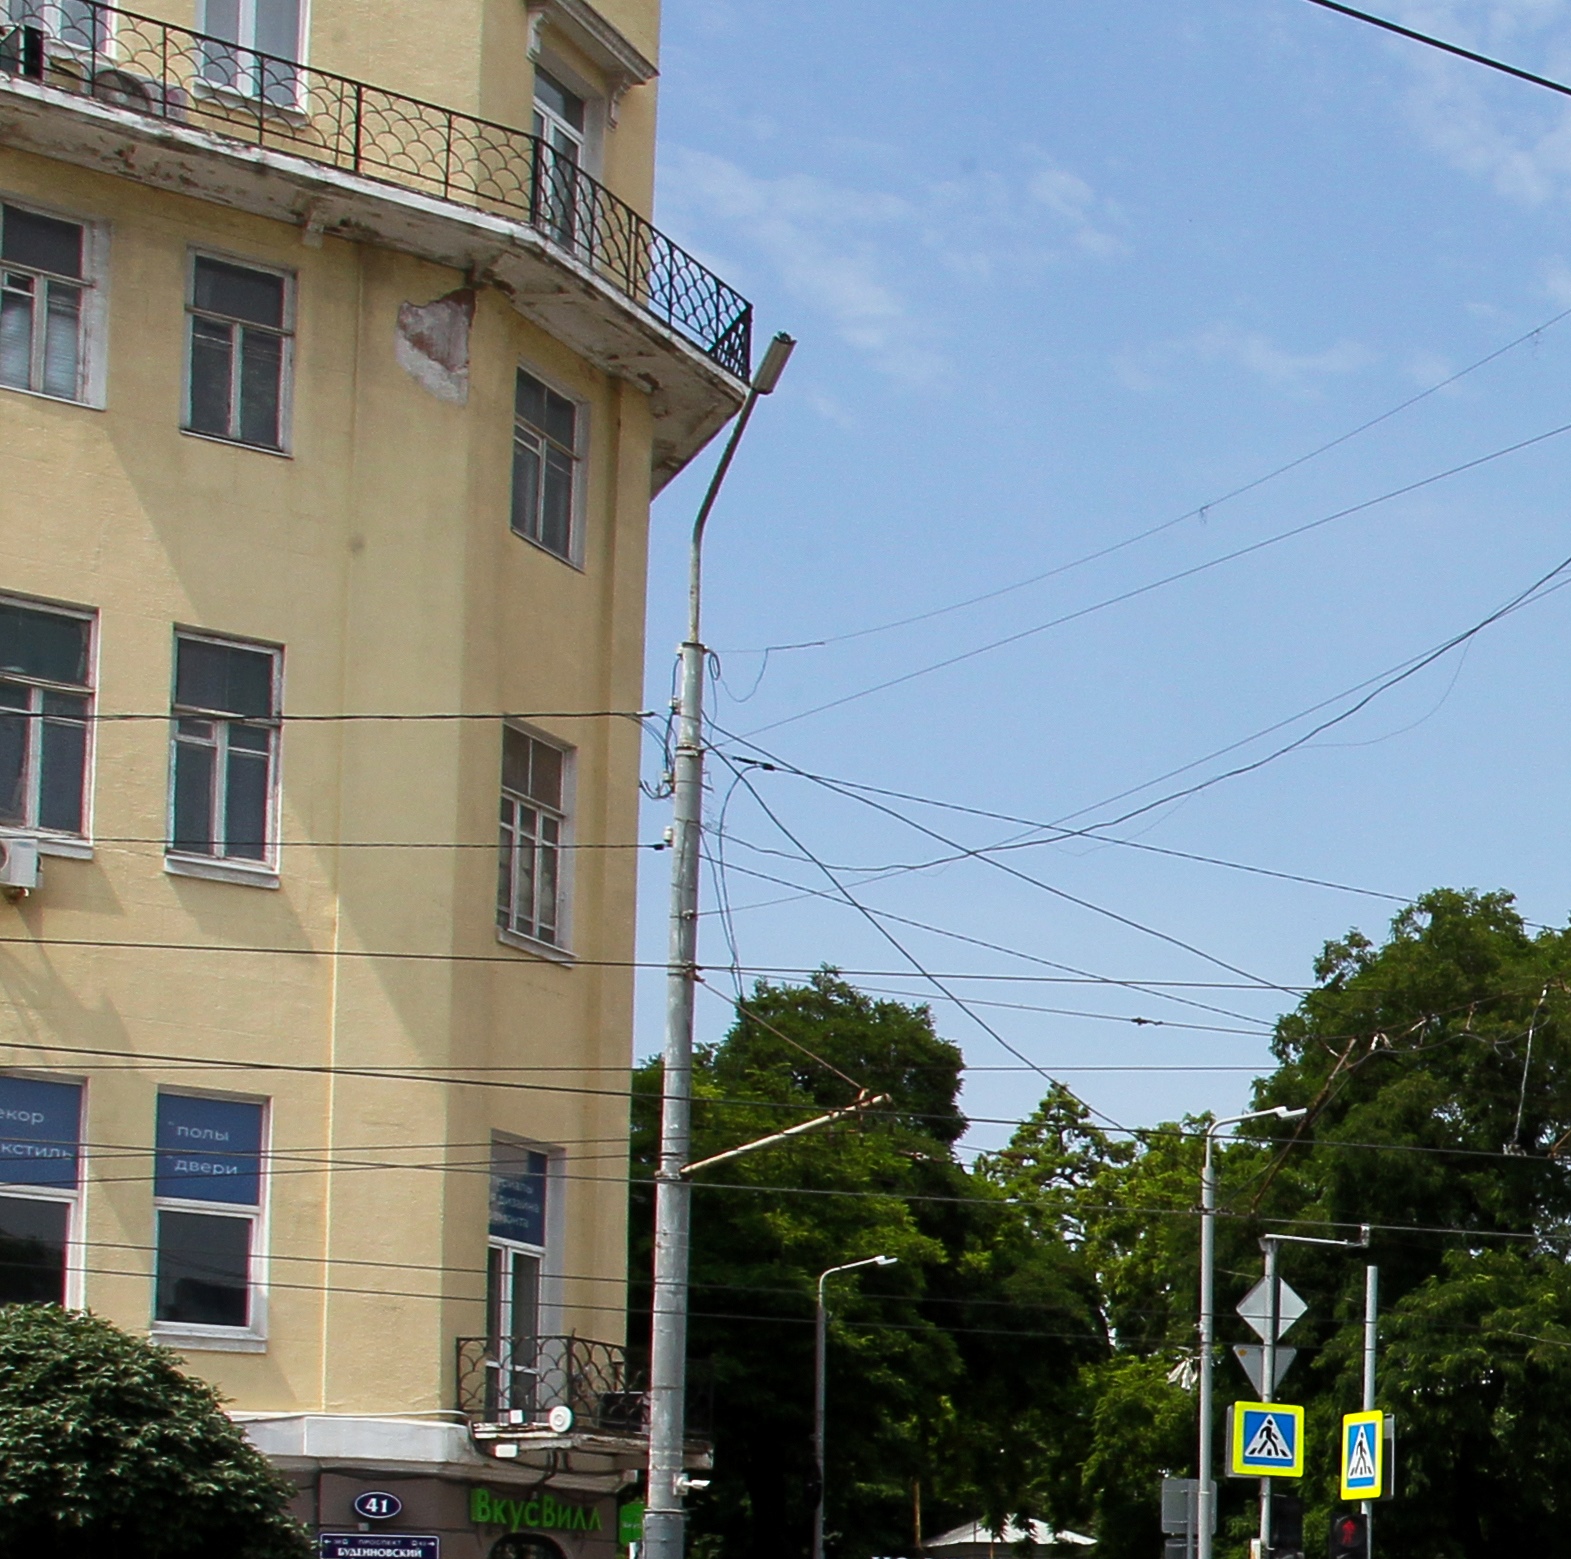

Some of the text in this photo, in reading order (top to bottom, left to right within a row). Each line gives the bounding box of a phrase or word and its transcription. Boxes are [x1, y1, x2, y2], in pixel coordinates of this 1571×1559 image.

[177, 1125, 230, 1142] полы
[174, 1158, 238, 1176] двери
[364, 1497, 389, 1514] 41
[470, 1487, 603, 1534] ВкусВилл
